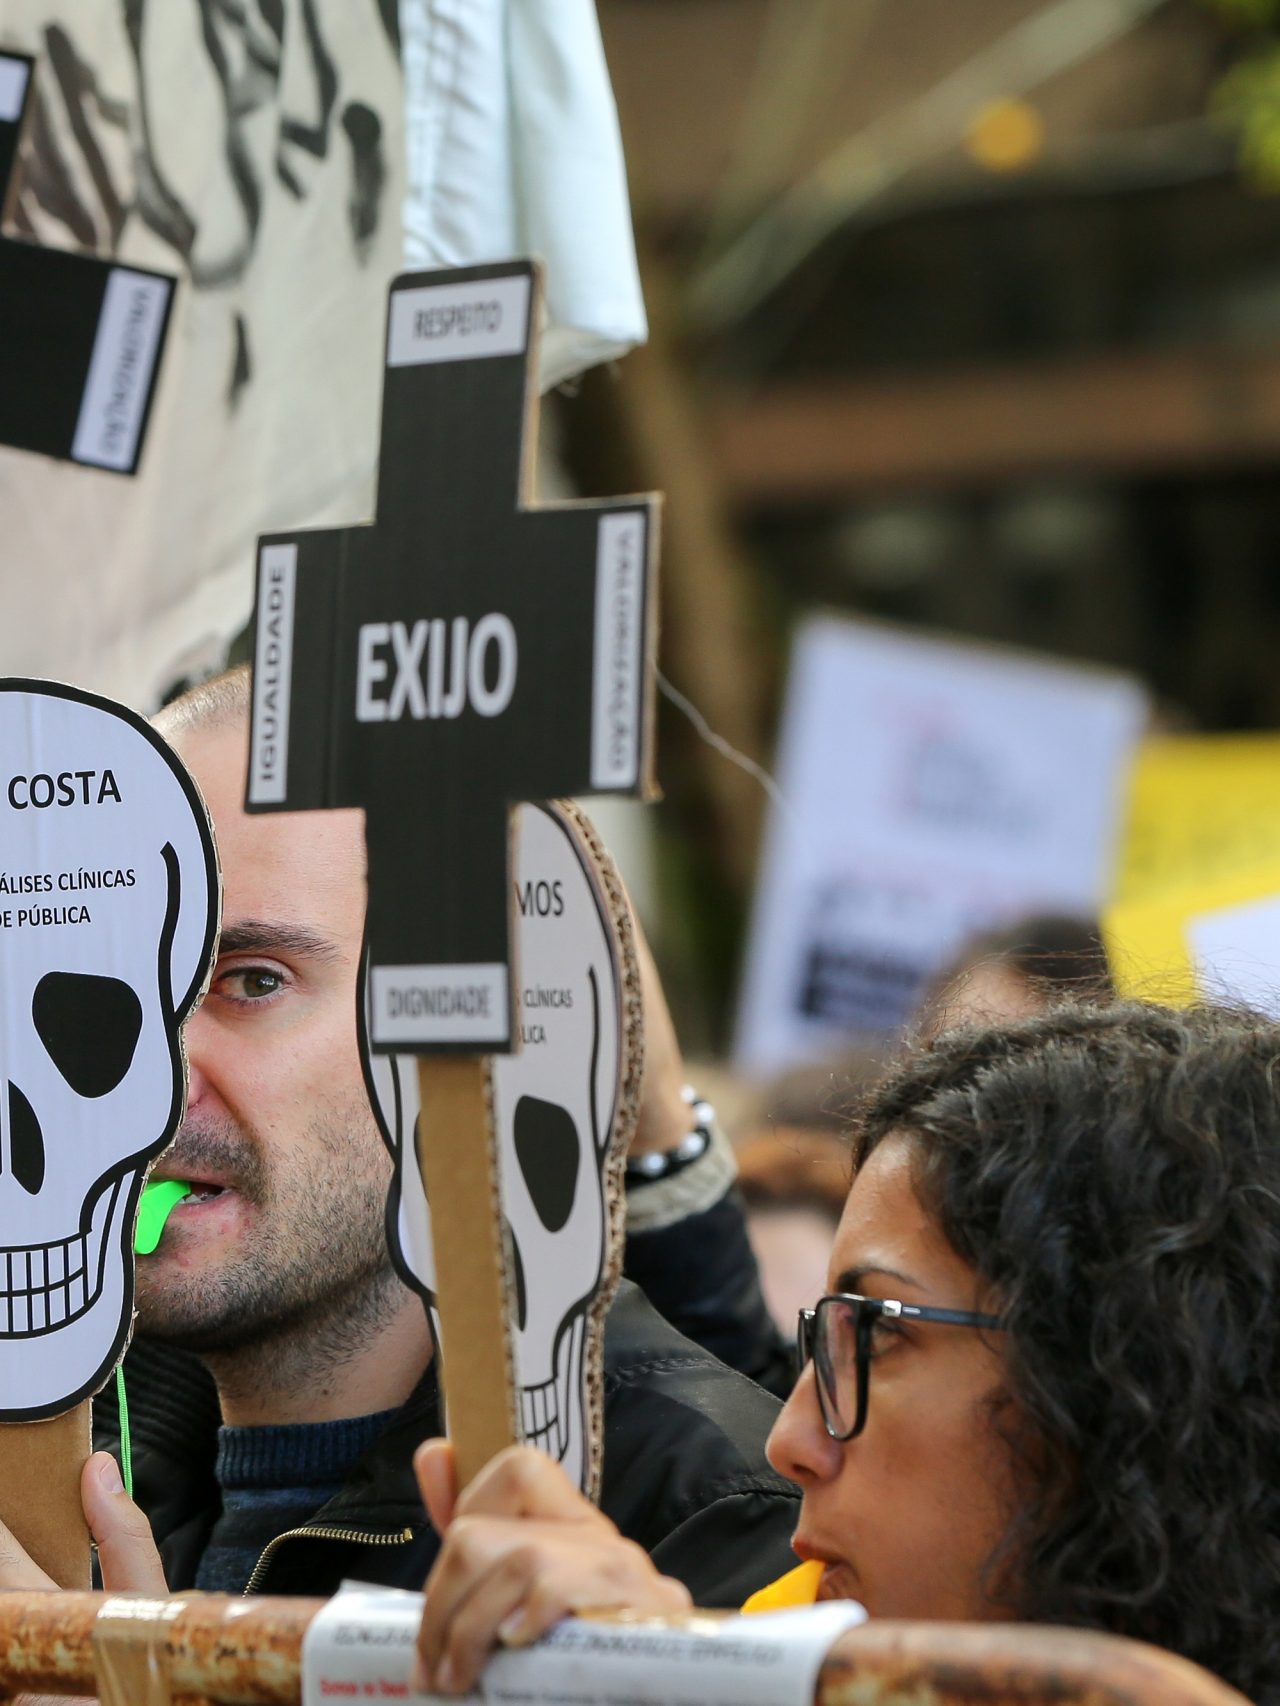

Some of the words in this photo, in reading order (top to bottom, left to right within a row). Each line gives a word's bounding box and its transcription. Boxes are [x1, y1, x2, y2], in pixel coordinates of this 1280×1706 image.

[413, 300, 502, 340] RESPEITO
[261, 565, 285, 781] IGUALDADE
[355, 612, 518, 722] EXIJO
[8, 769, 122, 810] COSTA
[58, 867, 136, 890] CLÍNICAS
[18, 904, 91, 927] PÚBLICA
[388, 985, 491, 1019] DIGNIDADE
[523, 984, 573, 1009] CLÍNICAS
[521, 1024, 547, 1044] LICA
